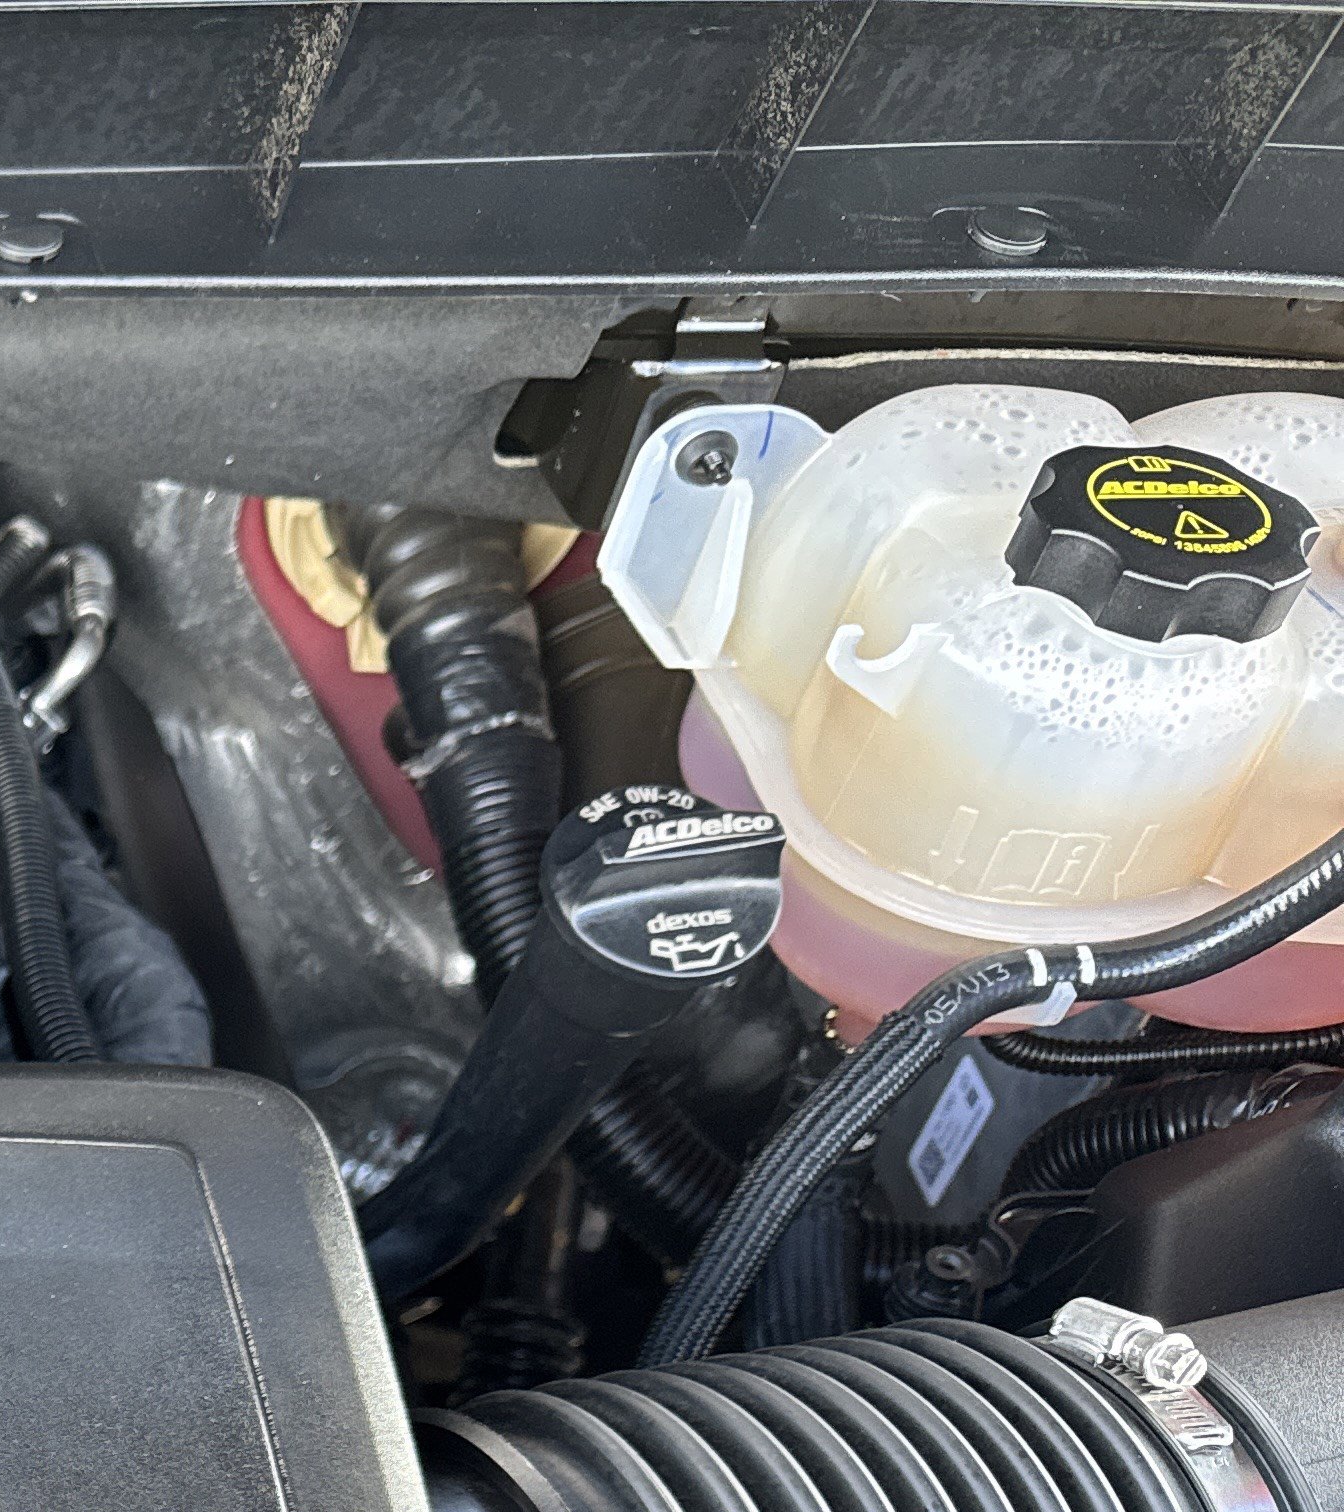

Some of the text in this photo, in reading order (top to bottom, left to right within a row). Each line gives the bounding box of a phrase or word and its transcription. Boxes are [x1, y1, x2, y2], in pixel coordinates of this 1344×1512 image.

[1099, 480, 1241, 495] ACDelco
[579, 785, 695, 824] SAE 0W-20
[627, 813, 774, 850] ACDelco
[646, 908, 734, 934] dexos
